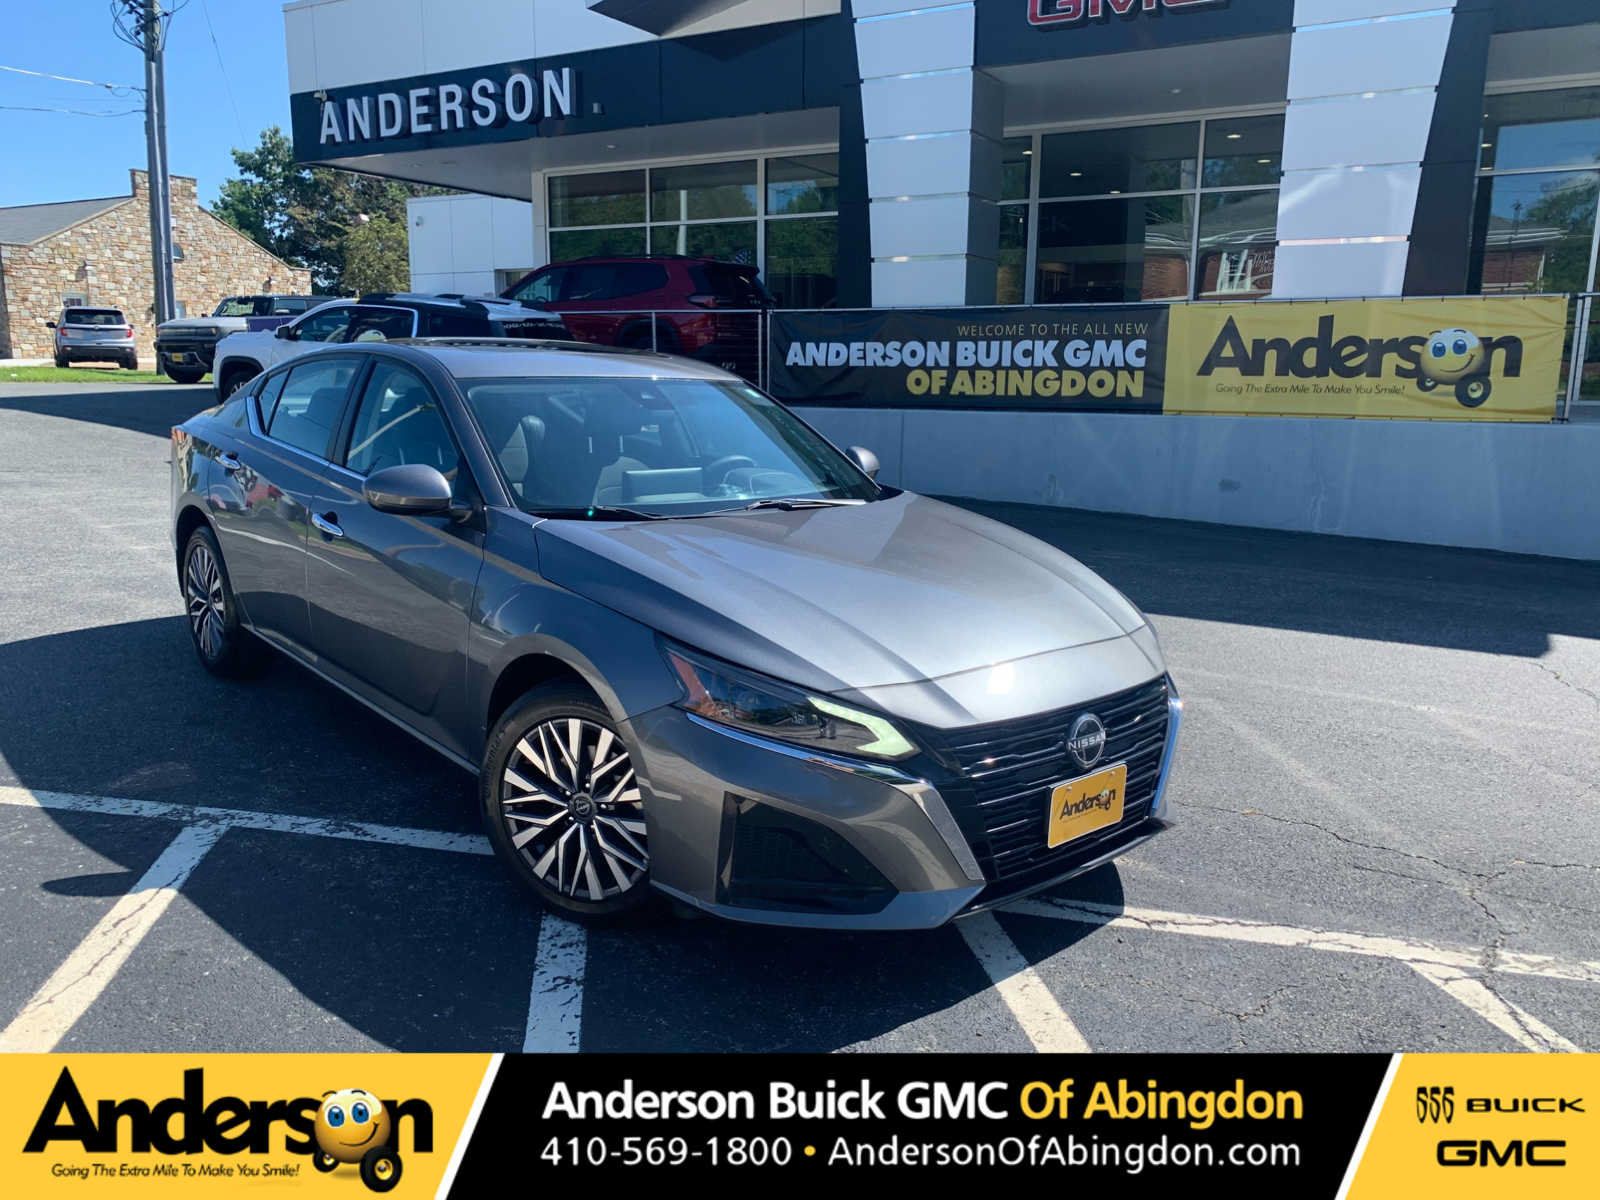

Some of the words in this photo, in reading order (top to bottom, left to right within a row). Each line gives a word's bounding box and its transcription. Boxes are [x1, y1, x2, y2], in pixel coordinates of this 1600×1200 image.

[319, 67, 573, 145] ANDERSON
[957, 323, 1025, 337] WELCOME
[1030, 323, 1048, 336] TO
[1052, 323, 1079, 336] THE
[1083, 323, 1109, 336] ALL
[1114, 322, 1149, 335] NEW
[785, 340, 950, 367] ANDERSON
[955, 340, 1057, 368] BUICK
[1063, 339, 1147, 368] GMC
[906, 369, 948, 395] OF
[950, 369, 1145, 398] ABINGDON
[1215, 383, 1243, 395] Going
[1245, 383, 1263, 393] The
[1264, 383, 1288, 394] Extra
[1289, 384, 1310, 394] Mile
[1312, 384, 1323, 394] To
[1324, 384, 1352, 394] Make
[1354, 384, 1373, 394] You
[1374, 385, 1406, 395] Smile!
